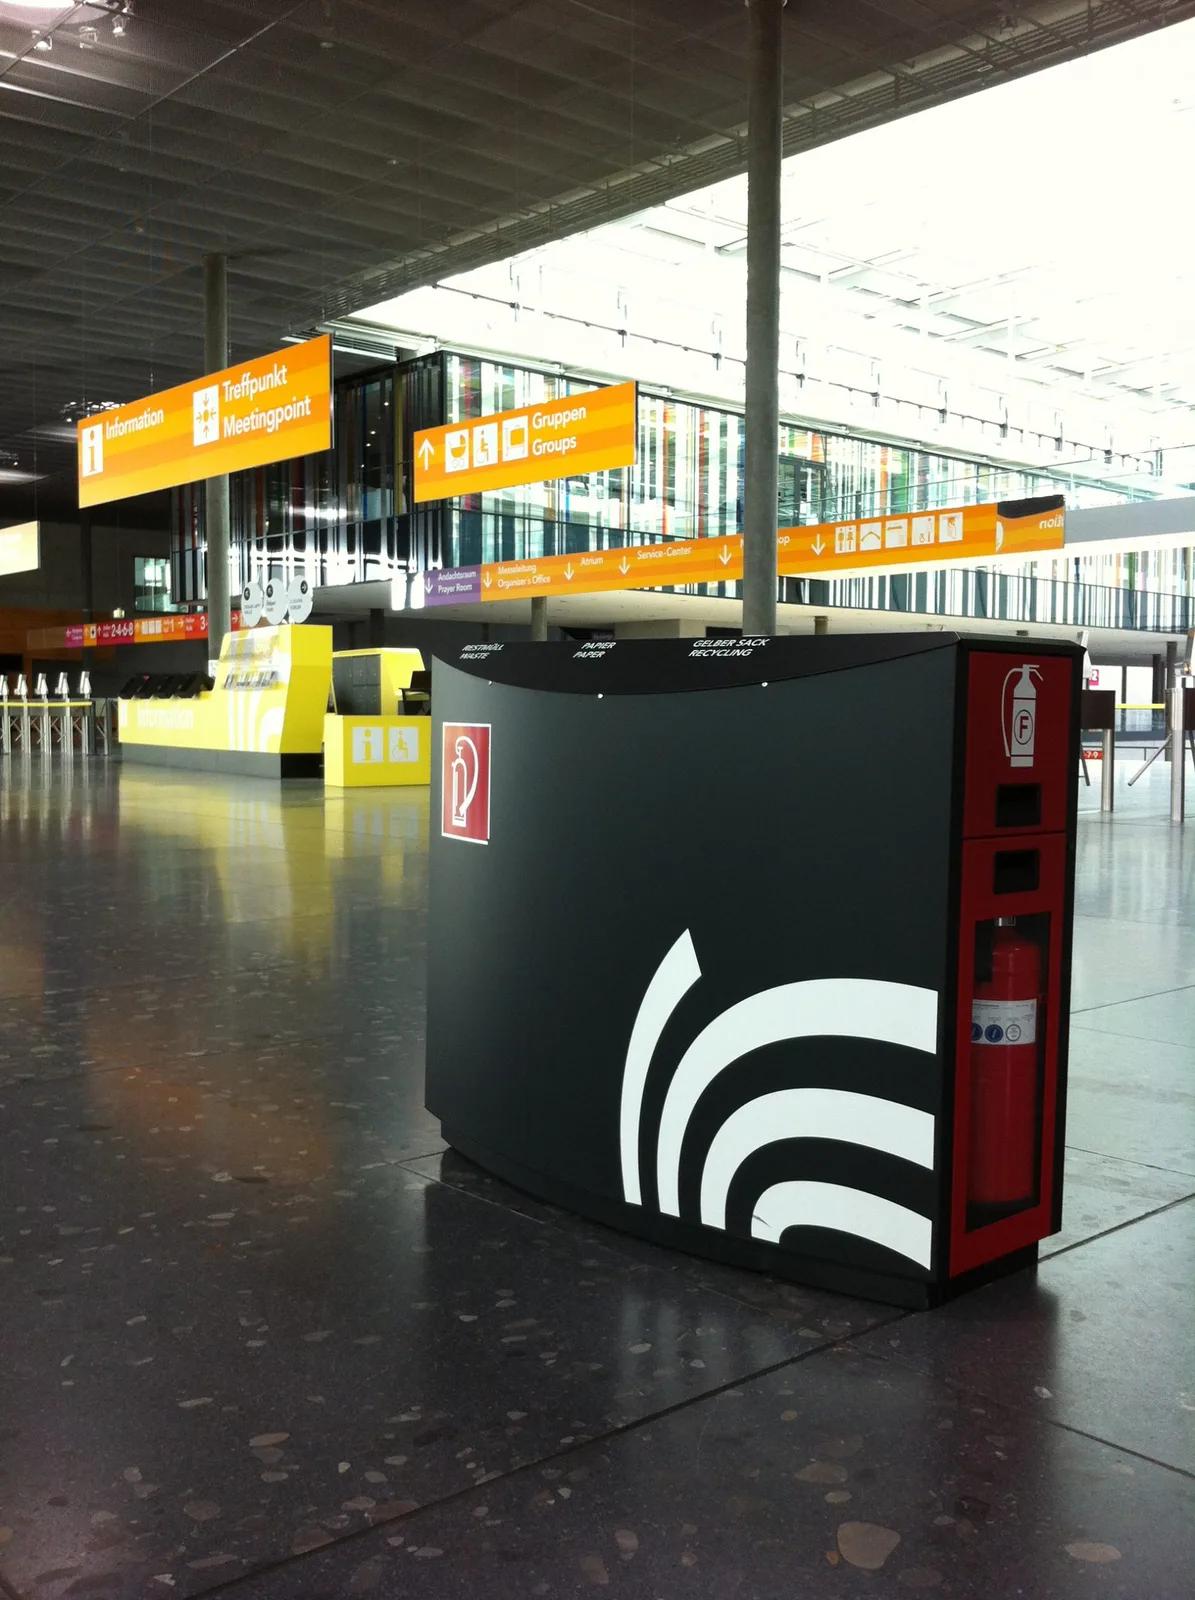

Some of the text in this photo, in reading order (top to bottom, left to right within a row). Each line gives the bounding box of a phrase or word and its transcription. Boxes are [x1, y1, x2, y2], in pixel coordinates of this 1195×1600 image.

[222, 364, 288, 401] Treffpunkt
[223, 394, 312, 438] Meetingpoint
[532, 406, 587, 430] Gruppen
[105, 407, 165, 440] Information
[532, 435, 577, 457] Groups
[637, 546, 692, 560] Service-Center
[580, 556, 604, 567] Atrium
[438, 584, 473, 595] Prayer Room
[580, 641, 617, 650] PAPIER
[693, 638, 771, 648] GELBER SACK
[458, 651, 491, 660] WASTE
[572, 650, 606, 659] PAPER
[688, 648, 753, 657] RECYCLING
